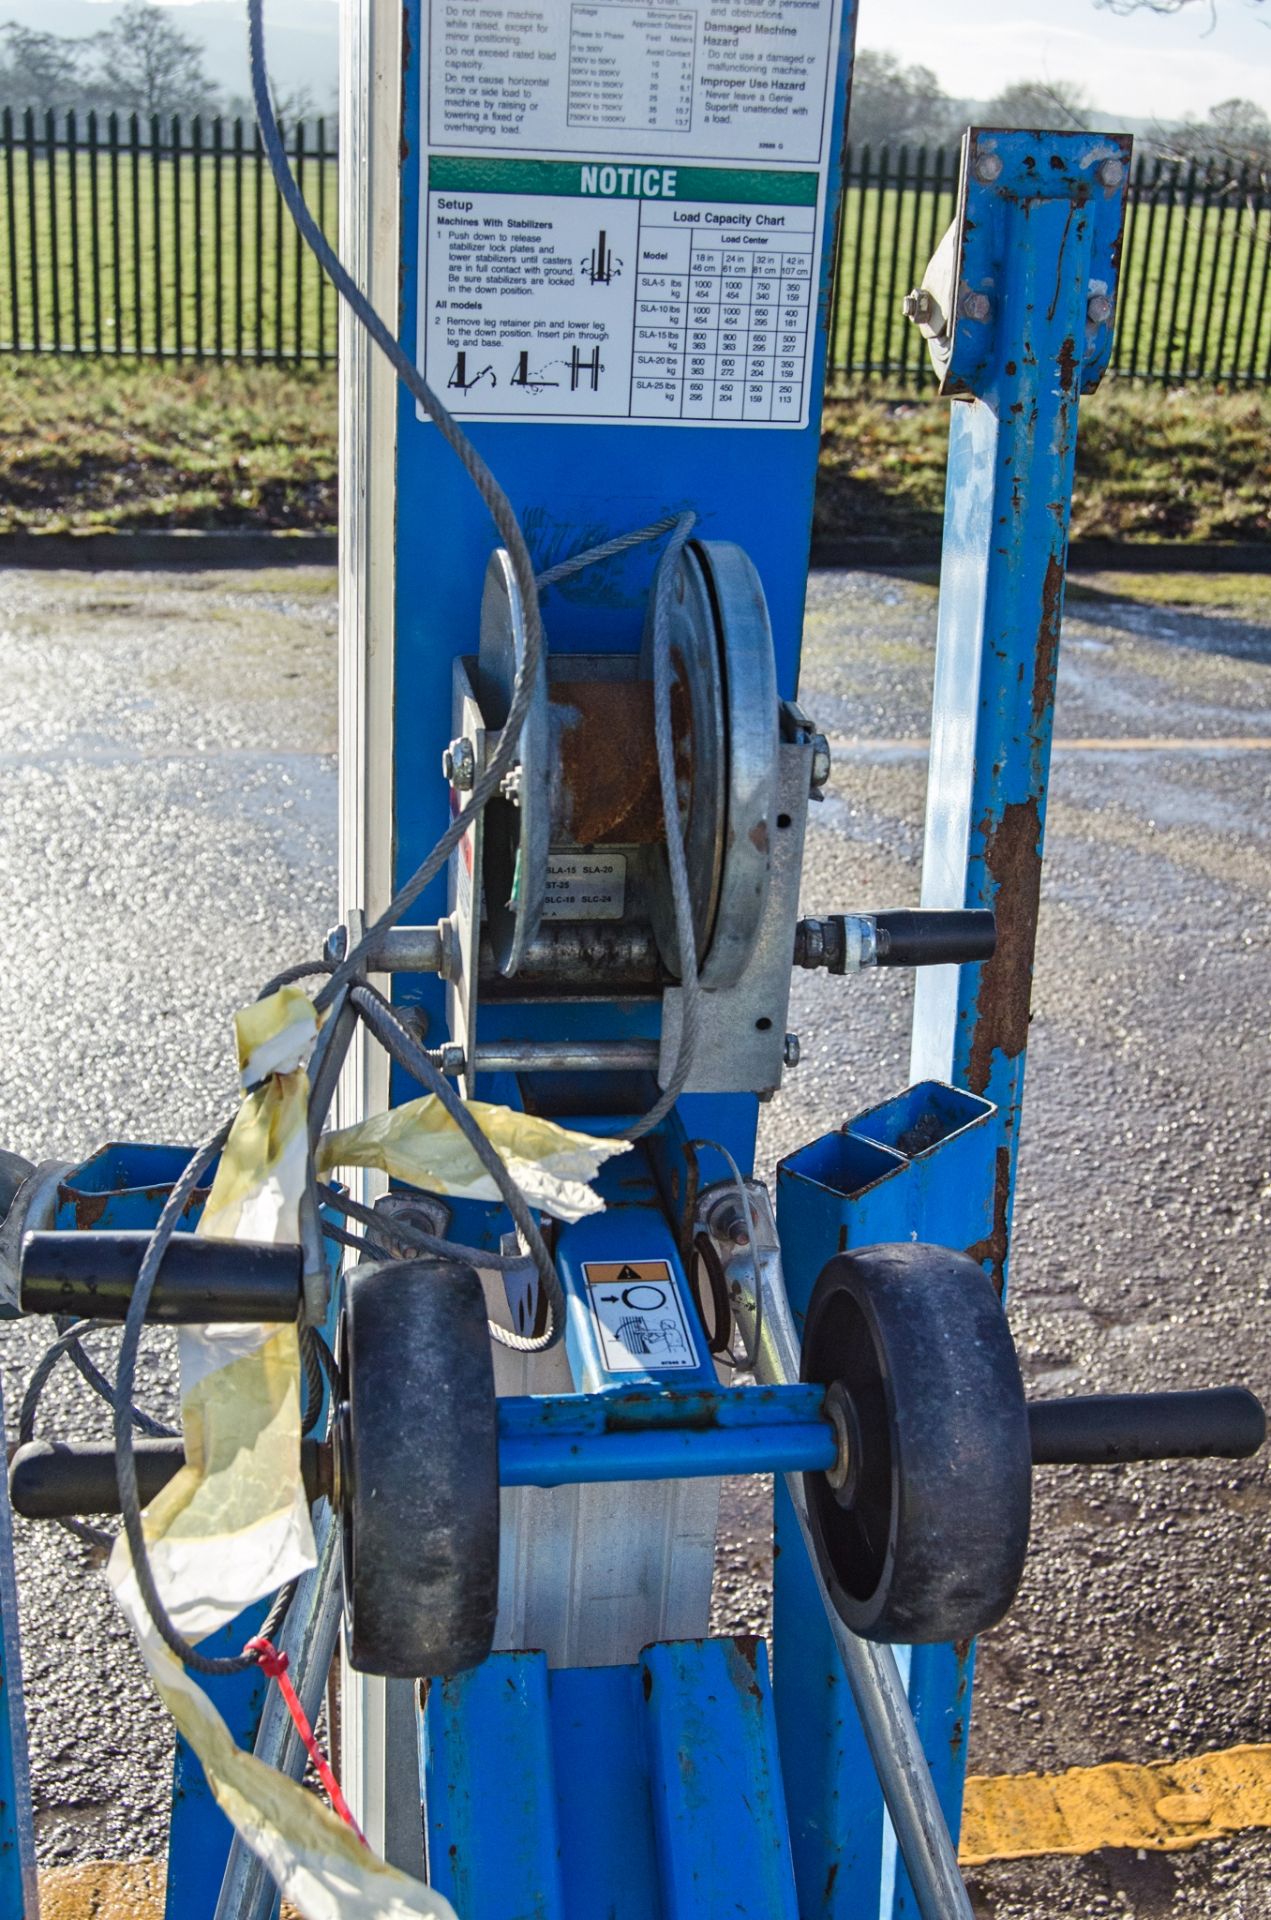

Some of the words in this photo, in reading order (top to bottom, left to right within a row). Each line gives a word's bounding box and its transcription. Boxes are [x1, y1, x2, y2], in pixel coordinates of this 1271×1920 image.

[710, 8, 726, 16] and
[704, 21, 751, 35] Damaged
[755, 24, 797, 36] Machine
[703, 35, 739, 47] Hazard
[445, 46, 457, 55] Do
[708, 50, 720, 58] Do
[723, 52, 736, 60] not
[740, 52, 754, 60] use
[766, 54, 804, 65] damaged
[707, 62, 767, 76] malfunctioning
[445, 73, 457, 82] Do
[461, 75, 475, 83] not
[479, 76, 504, 84] cause
[508, 76, 549, 87] horizontal
[701, 77, 745, 88] Improper
[749, 80, 768, 89] Use
[771, 80, 805, 91] Hazard
[445, 86, 466, 94] force
[481, 88, 498, 96] side
[502, 88, 519, 97] load
[523, 90, 532, 98] to
[706, 90, 730, 99] Never
[734, 92, 756, 101] leave
[769, 93, 793, 102] Genie
[444, 99, 480, 108] machine
[484, 100, 494, 110] by
[498, 101, 526, 112] raising
[705, 102, 739, 112] Superlift
[743, 105, 788, 115] unattended
[444, 110, 479, 122] lowering
[492, 112, 512, 121] fixed
[704, 115, 710, 123] a
[444, 123, 496, 135] overhanging
[580, 165, 678, 197] NOTICE
[438, 199, 473, 213] Setup
[437, 216, 479, 227] Machines
[483, 218, 503, 228] With
[507, 219, 553, 230] Stabilizers
[674, 212, 700, 223] Load
[705, 213, 751, 227] Capacity
[756, 215, 785, 226] Chart
[437, 231, 442, 239] 1
[449, 231, 470, 240] Push
[473, 233, 496, 242] down
[500, 234, 507, 242] to
[511, 234, 542, 243] release
[721, 235, 740, 243] Load
[743, 236, 768, 244] Center
[449, 242, 485, 251] stabilizer
[489, 243, 506, 252] lock
[510, 243, 534, 254] plates
[539, 245, 554, 253] and
[449, 253, 471, 261] lower
[476, 253, 516, 263] stabilizers
[521, 255, 538, 264] until
[543, 256, 572, 265] casters
[643, 251, 667, 260] Model
[449, 264, 462, 272] are
[466, 264, 472, 272] in
[476, 264, 488, 273] full
[491, 265, 521, 274] contact
[524, 265, 540, 274] with
[544, 266, 574, 276] ground.
[448, 274, 460, 282] Be
[486, 275, 527, 285] stabilizers
[530, 277, 544, 285] are
[548, 277, 574, 286] locked
[642, 279, 665, 287] SLA-5
[757, 283, 770, 291] 750
[459, 285, 472, 293] the
[475, 286, 497, 294] down
[500, 286, 534, 296] position.
[671, 289, 680, 299] kg
[451, 301, 482, 310] models
[641, 305, 668, 313] SLA-10
[669, 305, 680, 313] lbs
[435, 317, 441, 325] 2
[447, 317, 481, 326] Remove
[484, 318, 496, 328] leg
[500, 319, 530, 327] retainer
[534, 319, 546, 329] pin
[549, 320, 564, 328] and
[568, 321, 589, 329] lower
[592, 321, 605, 331] leg
[670, 315, 678, 325] kg
[447, 328, 455, 336] to
[458, 328, 471, 336] the
[475, 329, 497, 337] down
[500, 329, 533, 339] position.
[537, 330, 560, 339] Insert
[563, 331, 576, 341] pin
[579, 332, 609, 342] through
[447, 338, 459, 347] leg
[463, 339, 478, 347] and
[482, 339, 504, 347] base.
[668, 341, 677, 350] kg
[638, 356, 665, 364] SLA-20
[667, 367, 676, 376] kg
[665, 393, 674, 402] kg
